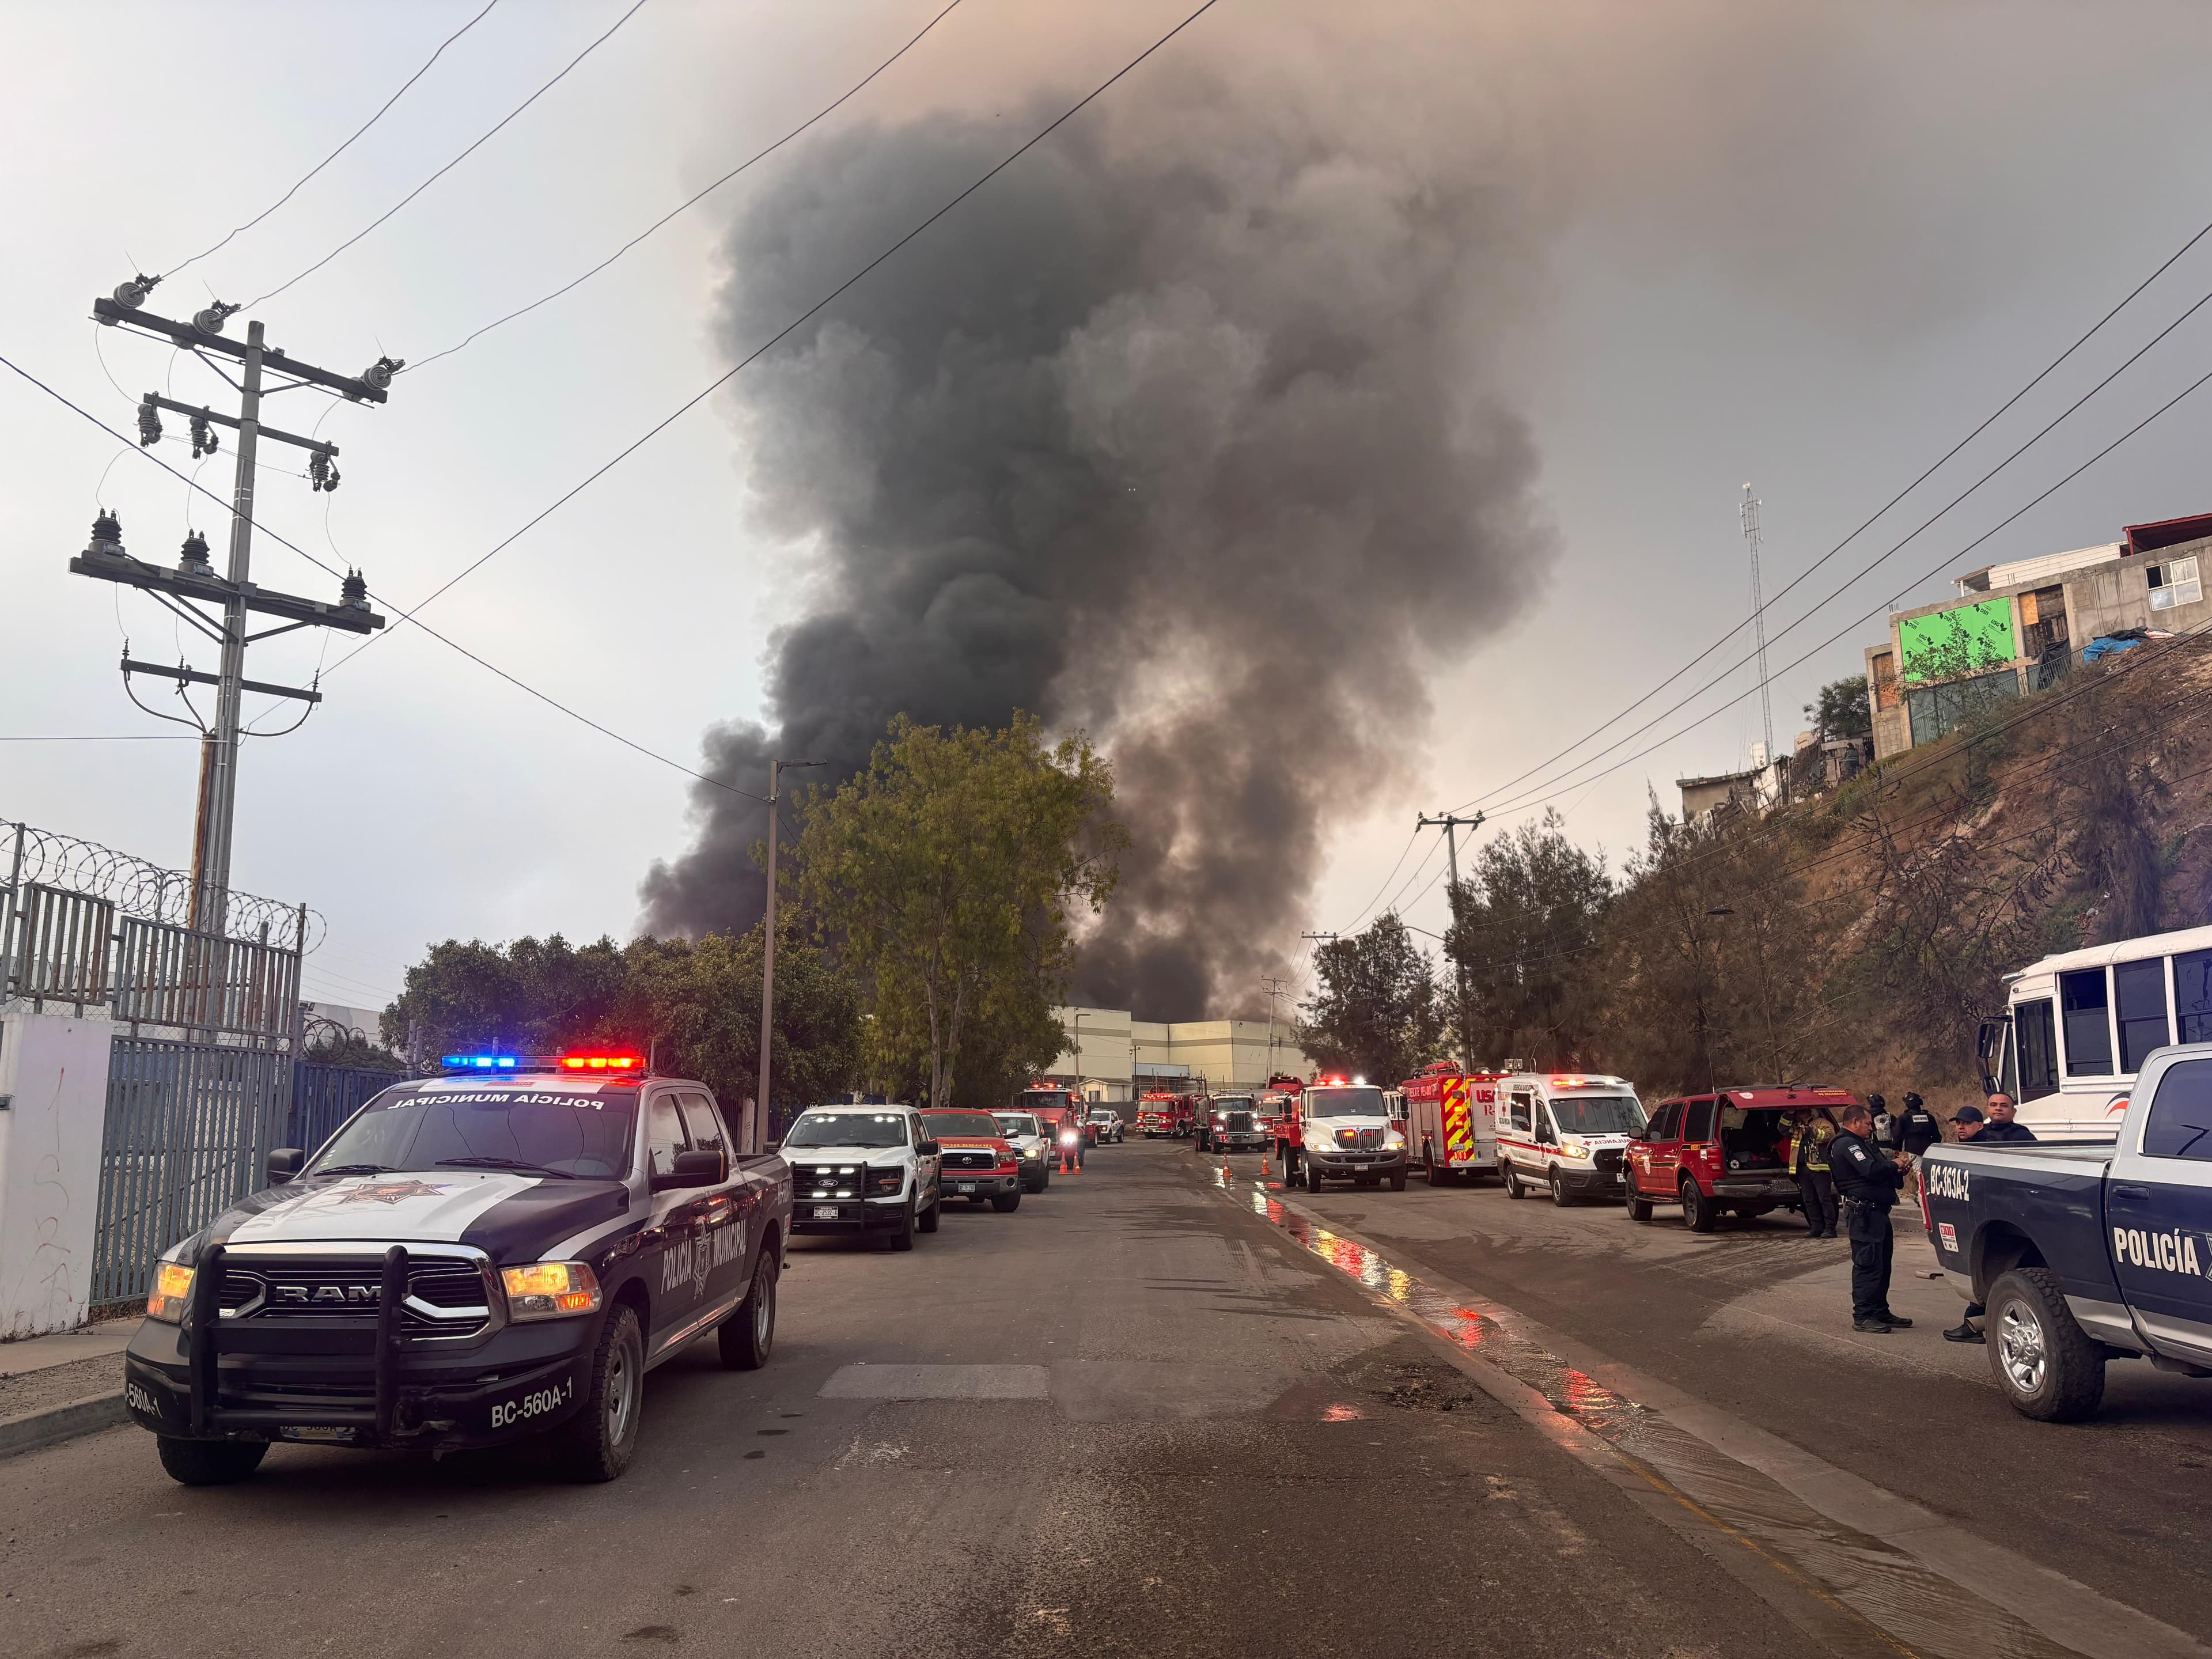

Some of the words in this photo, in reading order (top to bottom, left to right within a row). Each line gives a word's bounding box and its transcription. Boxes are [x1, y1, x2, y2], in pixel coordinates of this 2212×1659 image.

[1908, 622, 1917, 630] USG
[1918, 633, 1927, 641] USG
[1931, 1164, 1970, 1202] BC-363A-2
[713, 1219, 747, 1268] MUNICIPAL
[1941, 1226, 1953, 1236] 911
[2113, 1227, 2202, 1277] POLICÍA
[276, 1286, 382, 1302] RAM
[125, 1382, 163, 1419] -560A-1
[492, 1376, 572, 1428] BC-560A-1
